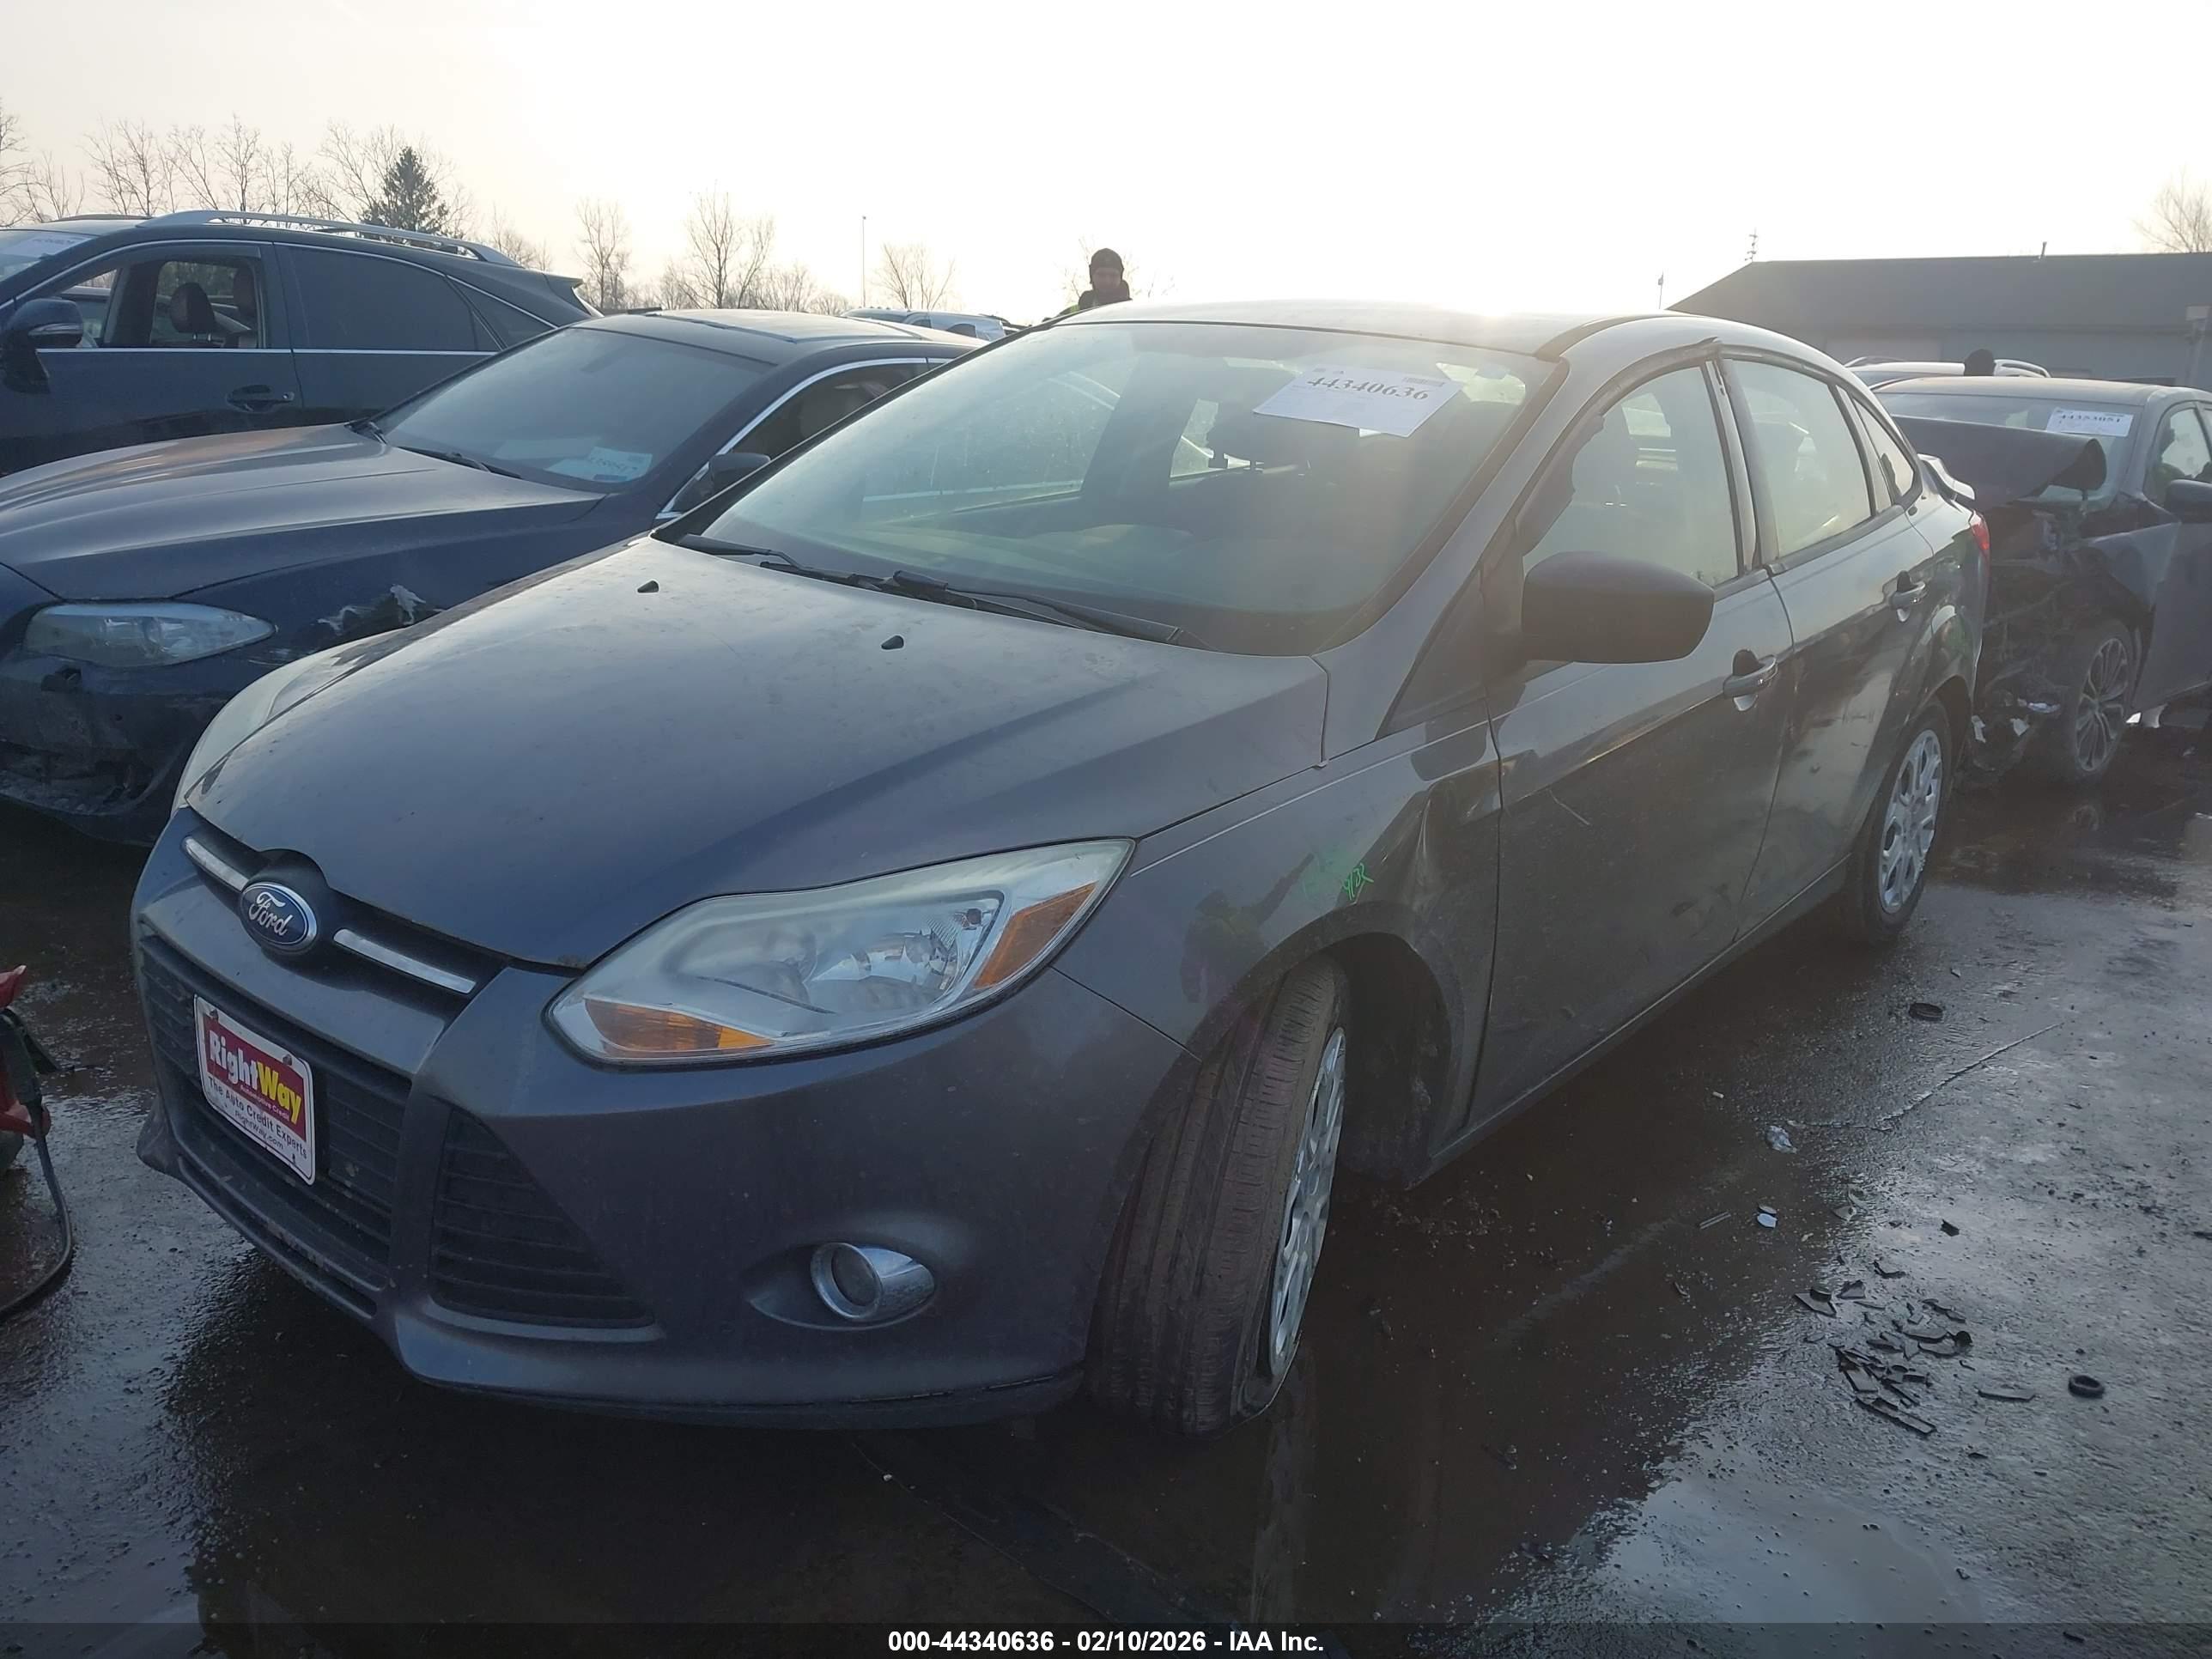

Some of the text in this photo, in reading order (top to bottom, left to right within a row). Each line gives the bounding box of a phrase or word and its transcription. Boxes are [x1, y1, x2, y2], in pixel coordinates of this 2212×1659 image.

[1307, 376, 1431, 400] 44340636
[248, 891, 294, 936] Ford
[208, 1076, 307, 1159] The Auto Credit Experts
